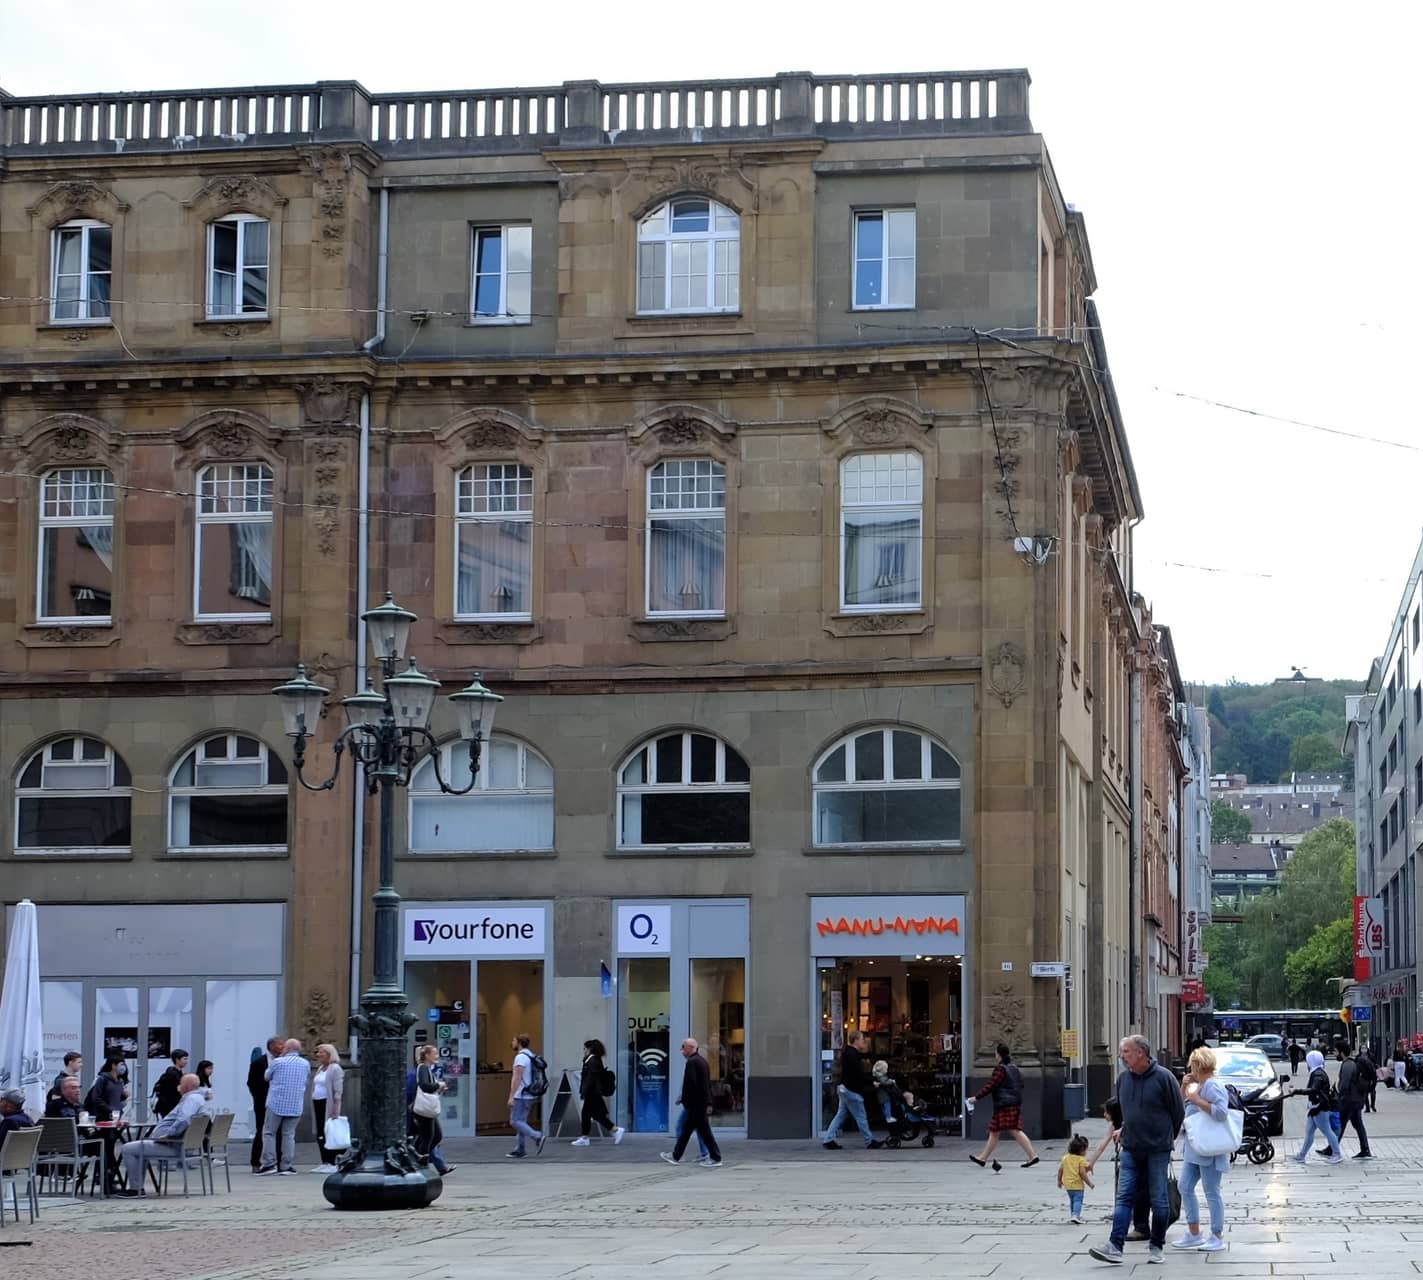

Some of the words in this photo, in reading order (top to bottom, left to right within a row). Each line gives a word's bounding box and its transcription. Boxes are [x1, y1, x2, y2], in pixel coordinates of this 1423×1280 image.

[423, 916, 534, 945] yourfone
[816, 915, 960, 938] NANU-NANA
[1371, 924, 1383, 951] LBS
[1187, 910, 1197, 975] SPIEL
